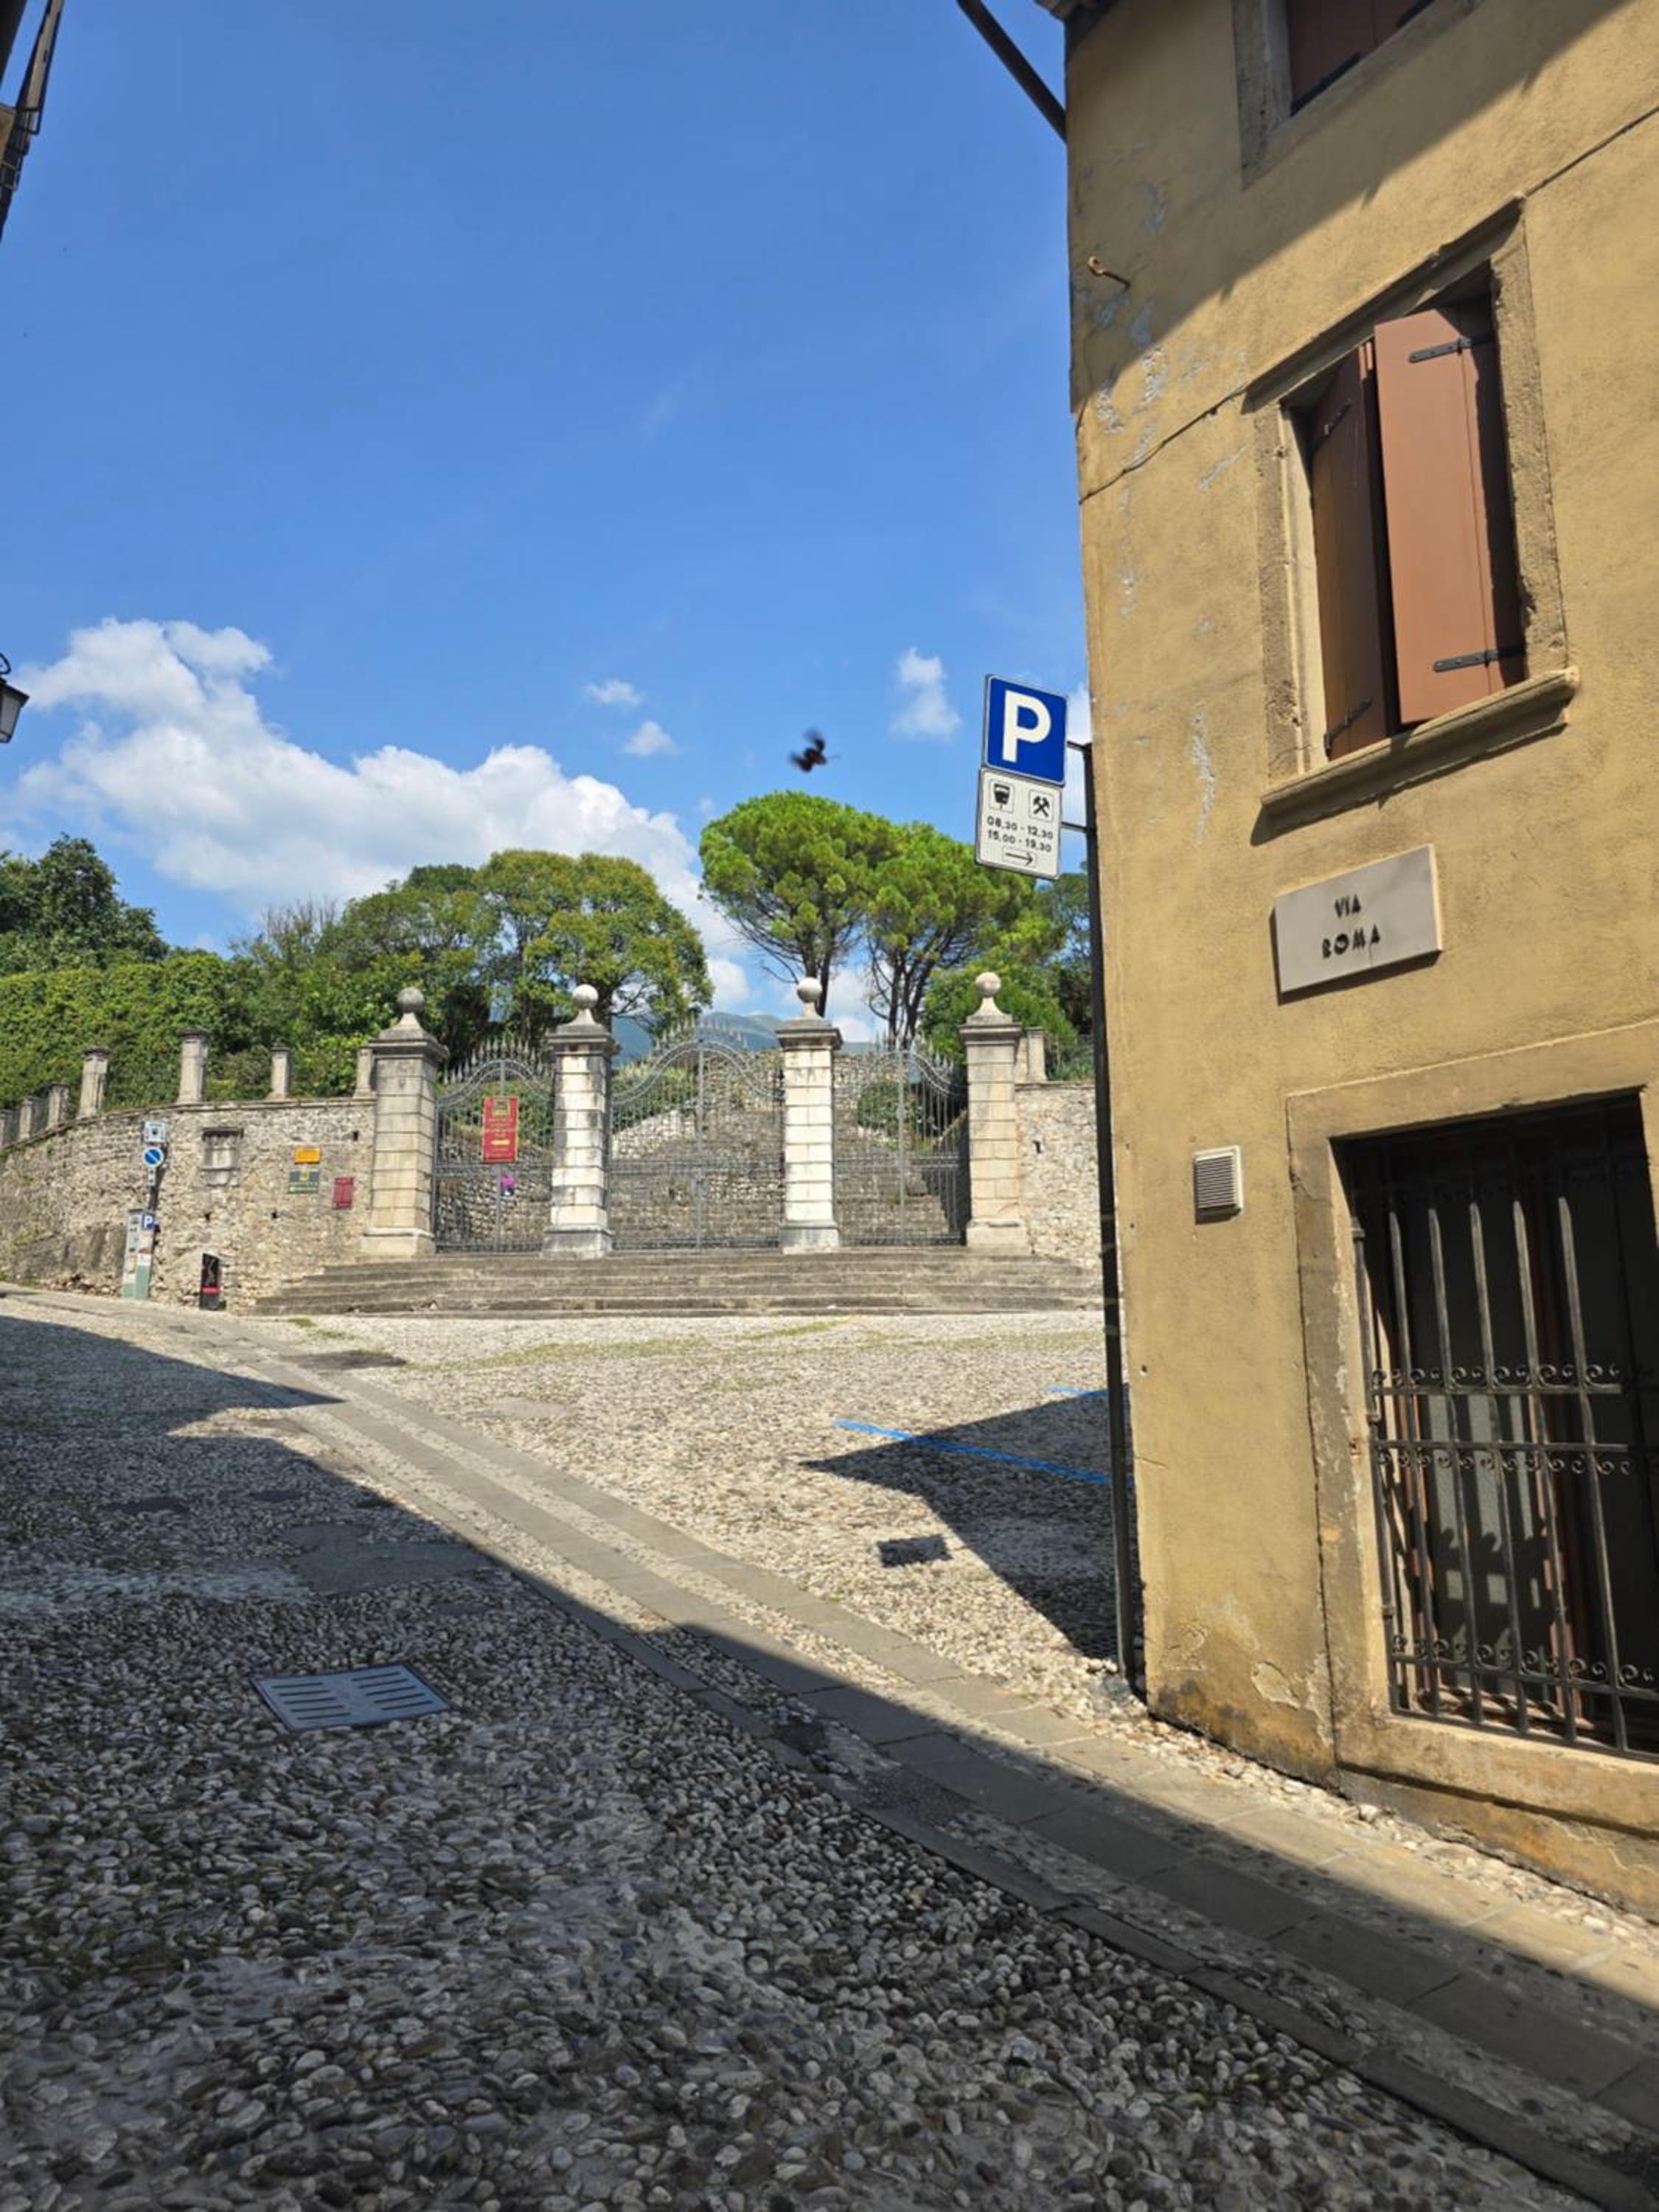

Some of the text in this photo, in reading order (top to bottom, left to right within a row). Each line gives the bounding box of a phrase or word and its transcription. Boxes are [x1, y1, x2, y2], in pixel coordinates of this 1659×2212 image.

[1002, 689, 1051, 763] P
[1334, 894, 1362, 919] VIA
[1322, 923, 1381, 959] ROMA
[143, 1215, 153, 1229] P
